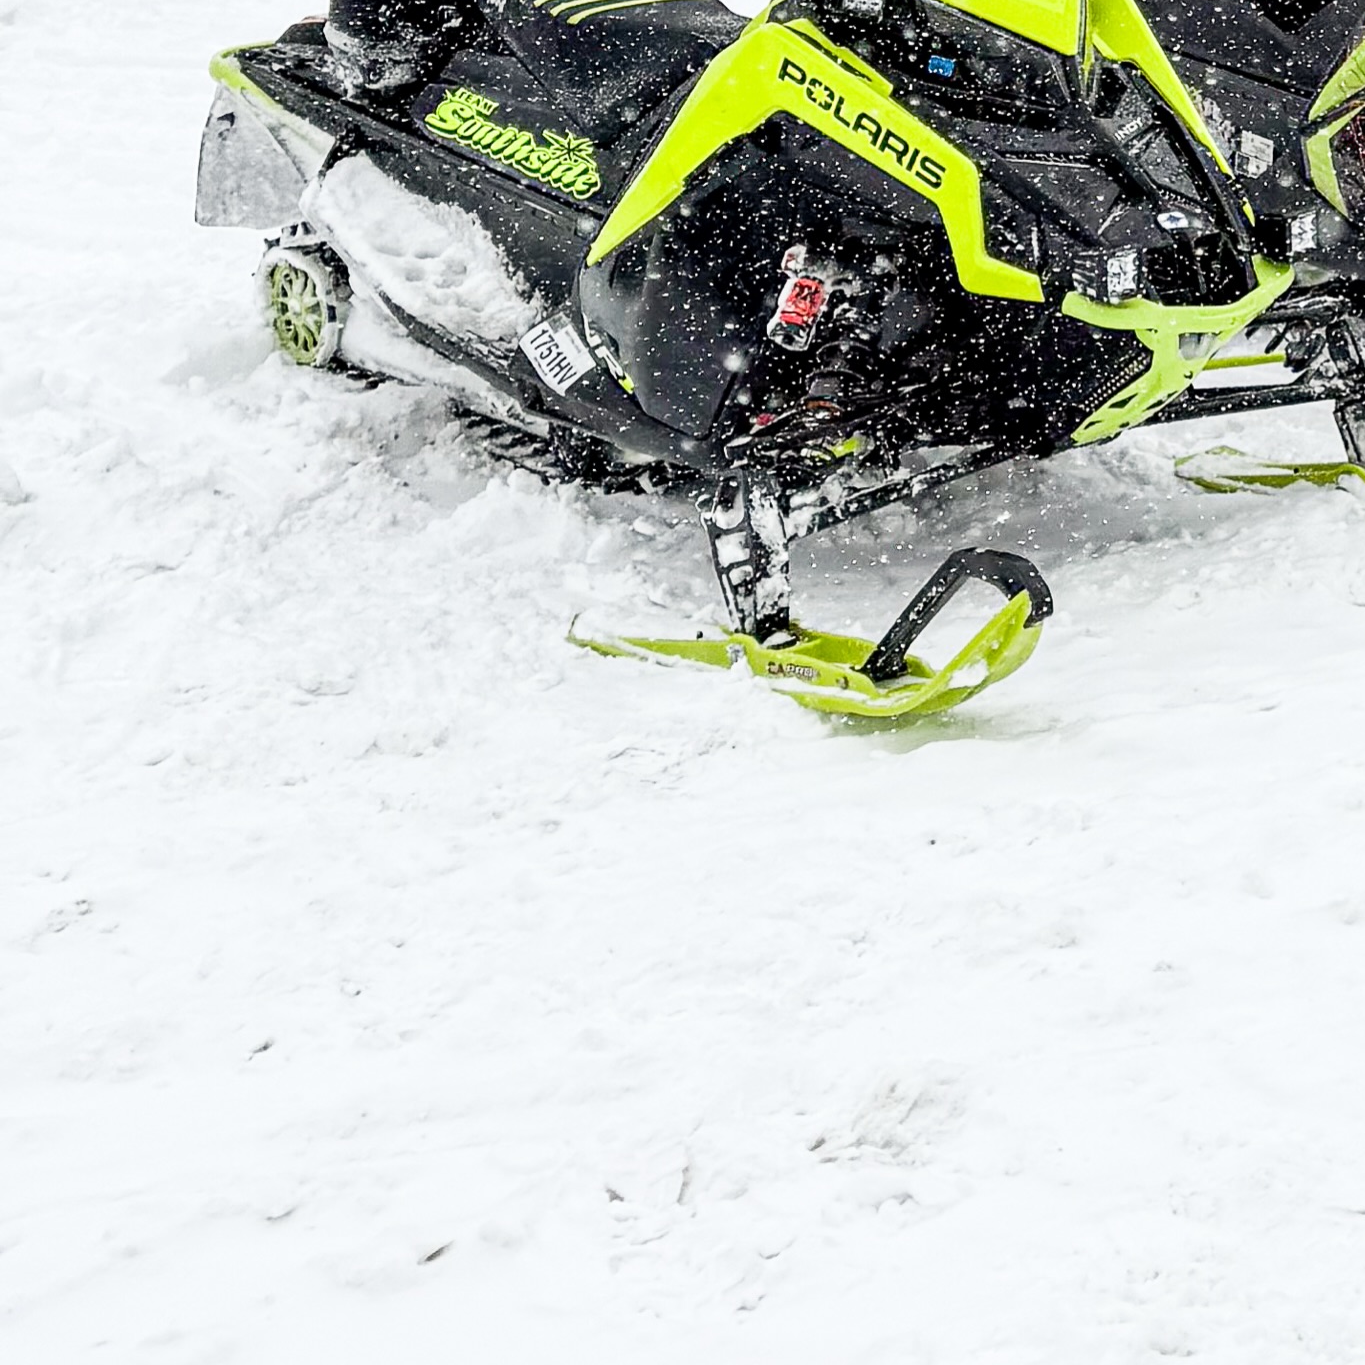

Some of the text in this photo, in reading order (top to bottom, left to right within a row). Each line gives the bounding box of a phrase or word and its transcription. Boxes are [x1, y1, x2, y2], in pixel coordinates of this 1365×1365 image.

[455, 87, 499, 117] TEAM
[778, 57, 947, 189] POLARIS
[1115, 118, 1145, 141] INDY
[425, 99, 602, 200] Southside
[529, 328, 578, 386] 1751HV
